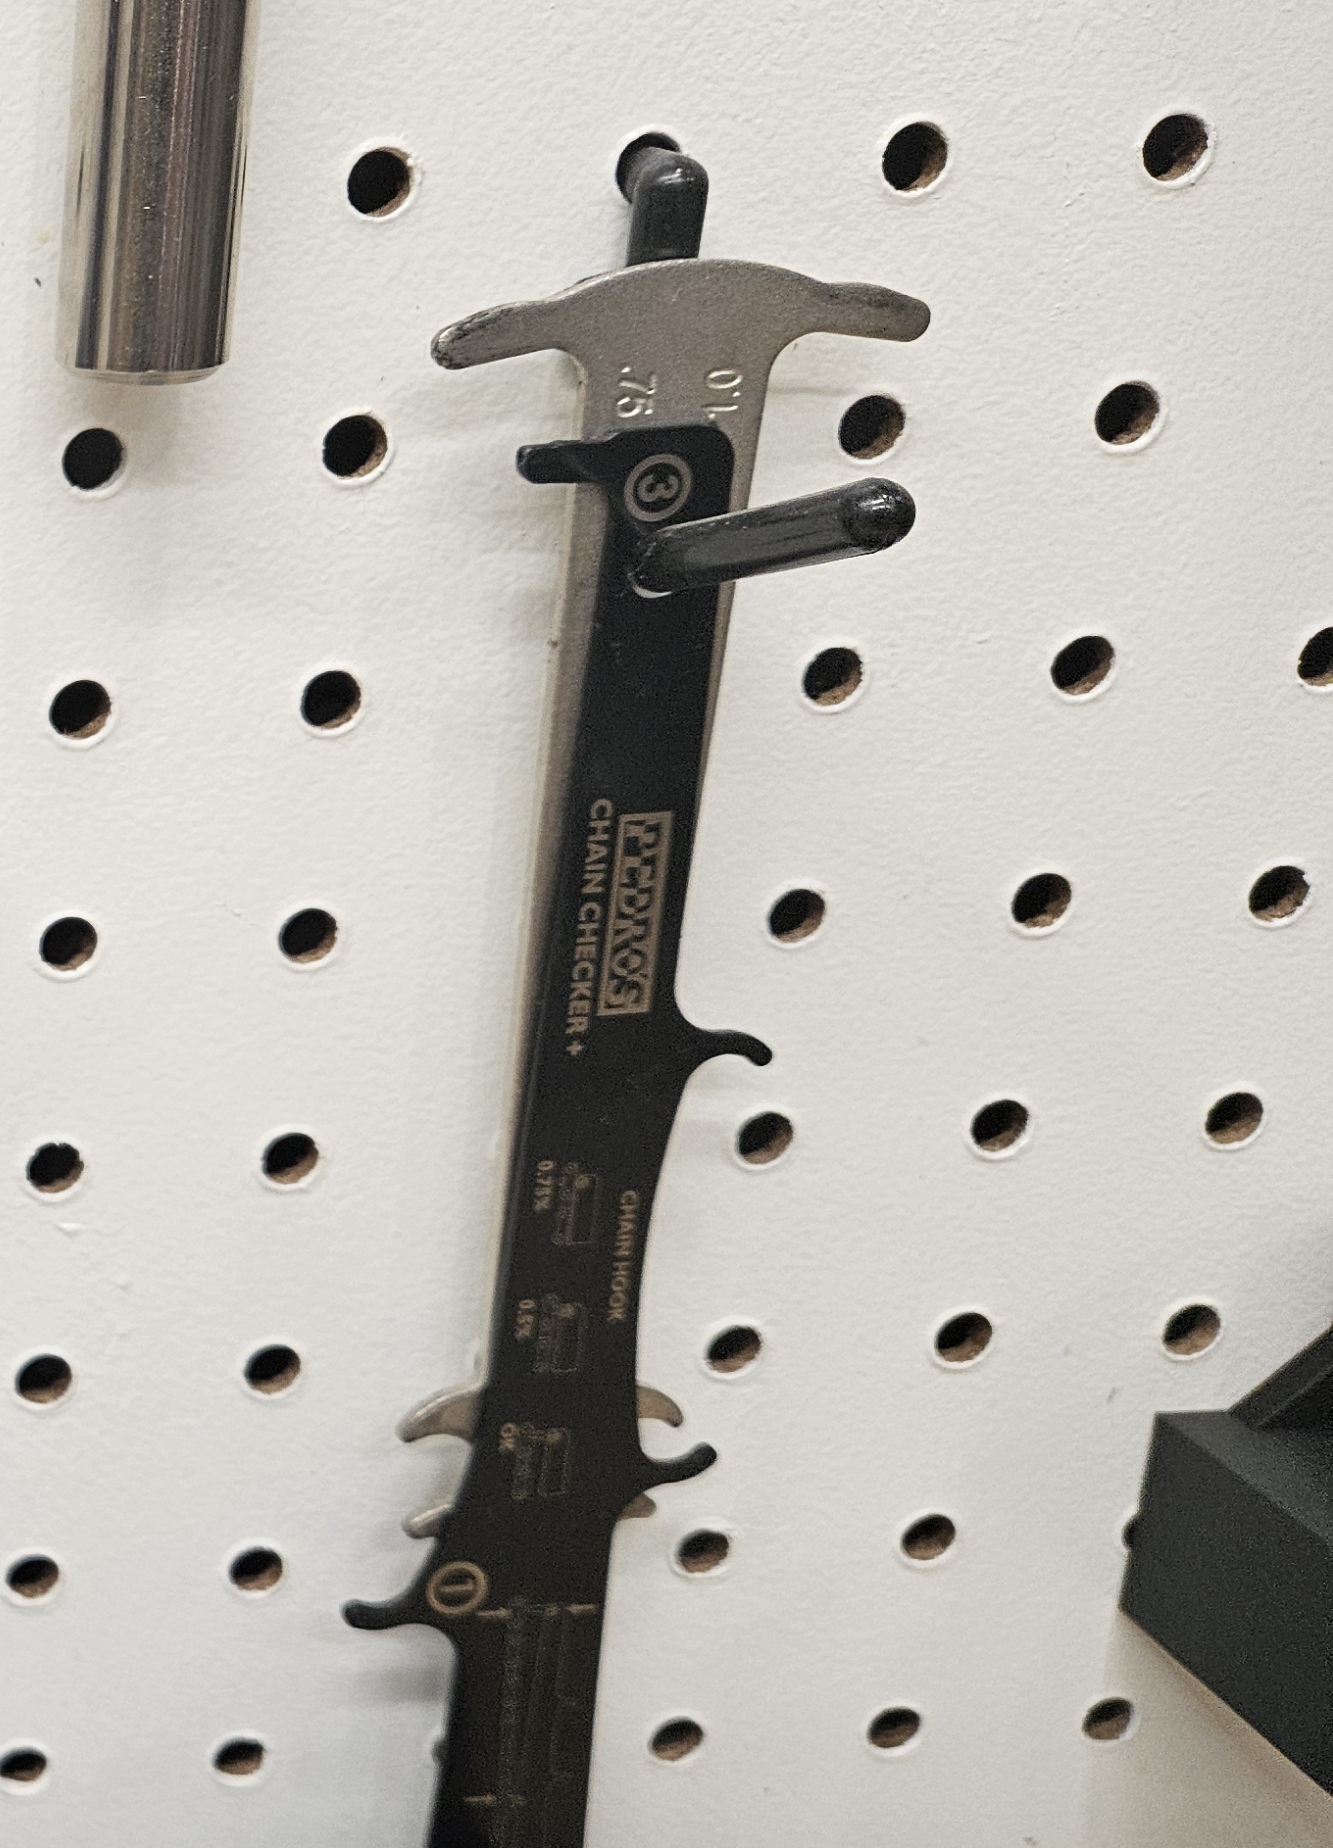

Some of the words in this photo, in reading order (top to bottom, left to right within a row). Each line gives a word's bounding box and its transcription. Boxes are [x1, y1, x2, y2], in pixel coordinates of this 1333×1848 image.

[616, 365, 658, 418] .75
[701, 369, 744, 420] 1.0
[580, 798, 614, 895] CHAIN
[564, 901, 601, 1035] CHECKER
[613, 1189, 642, 1257] CHAIN
[606, 1260, 632, 1324] HOOK
